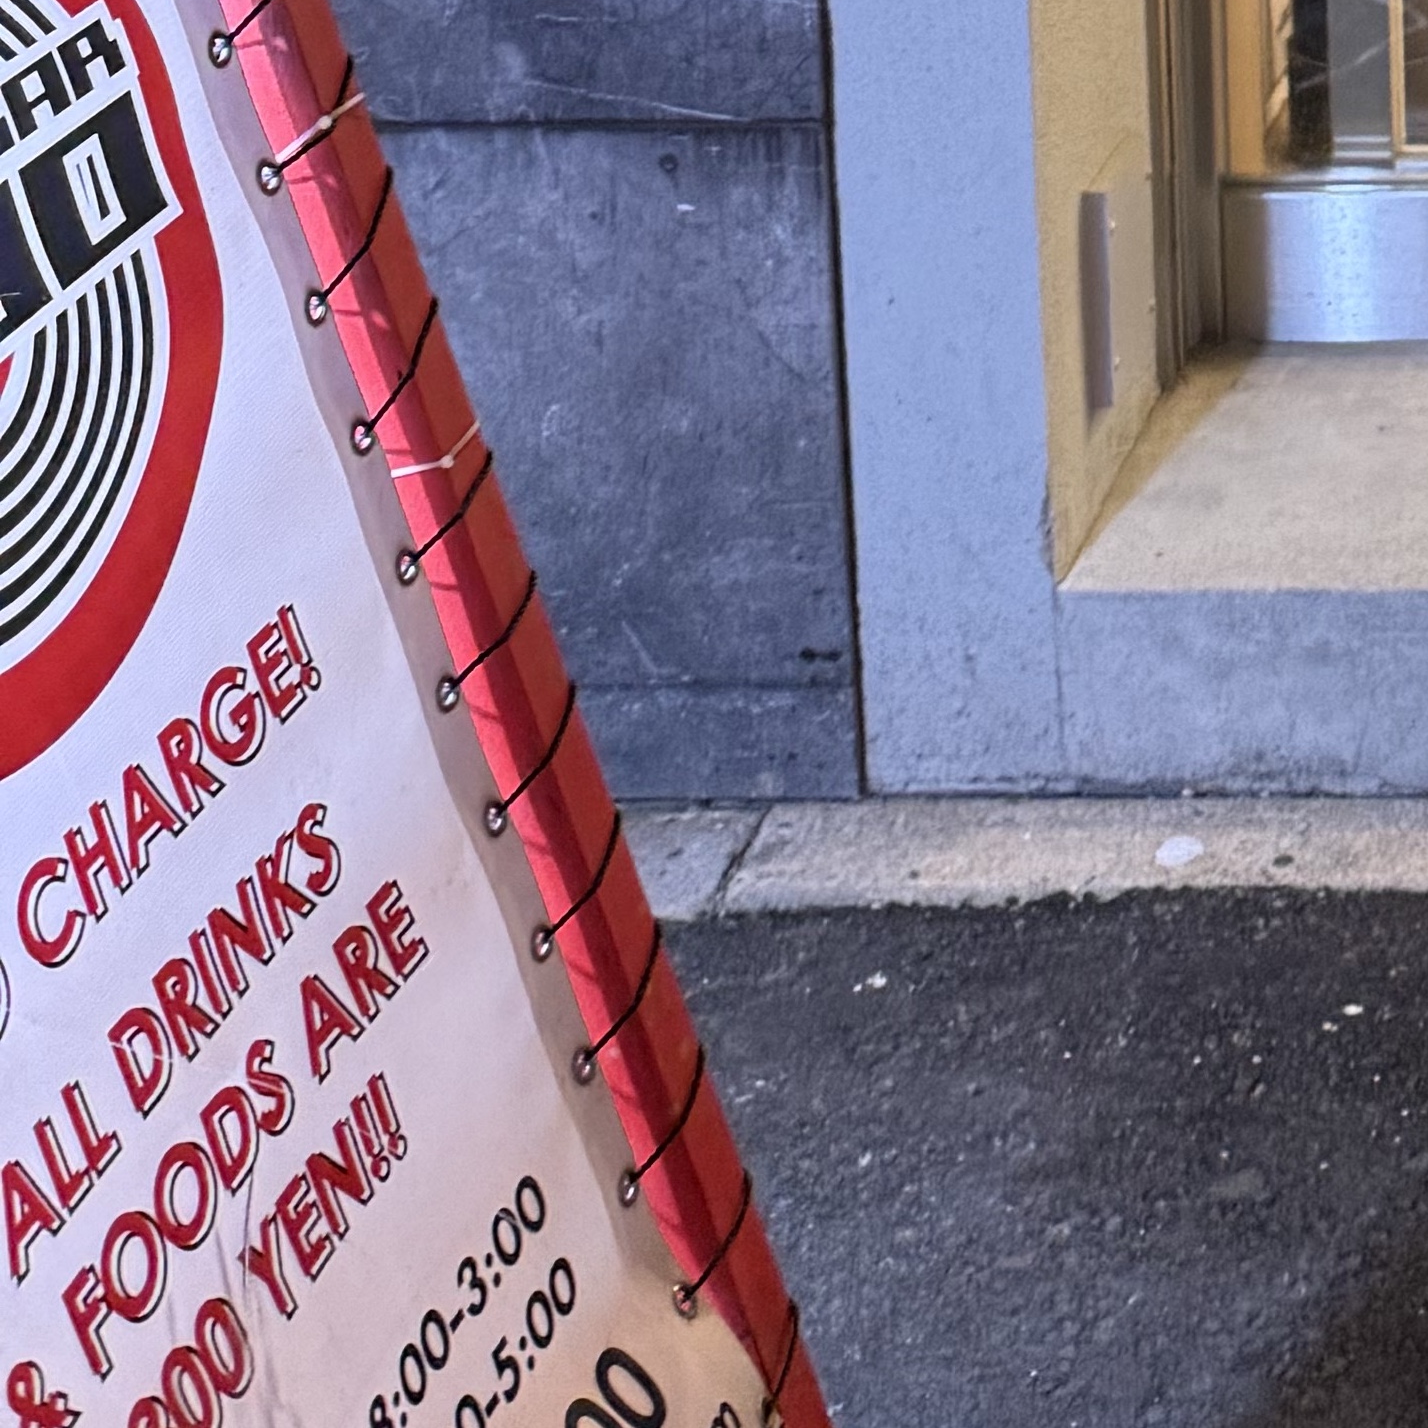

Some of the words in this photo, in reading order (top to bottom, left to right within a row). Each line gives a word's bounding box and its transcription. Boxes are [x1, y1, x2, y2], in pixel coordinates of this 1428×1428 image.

[17, 604, 323, 969] CHARGE!
[1, 1081, 122, 1286] ALL
[107, 803, 342, 1120] DRINKS
[62, 1039, 295, 1381] FOODS
[301, 880, 430, 1085] ARE
[239, 1073, 408, 1321] YEN!!
